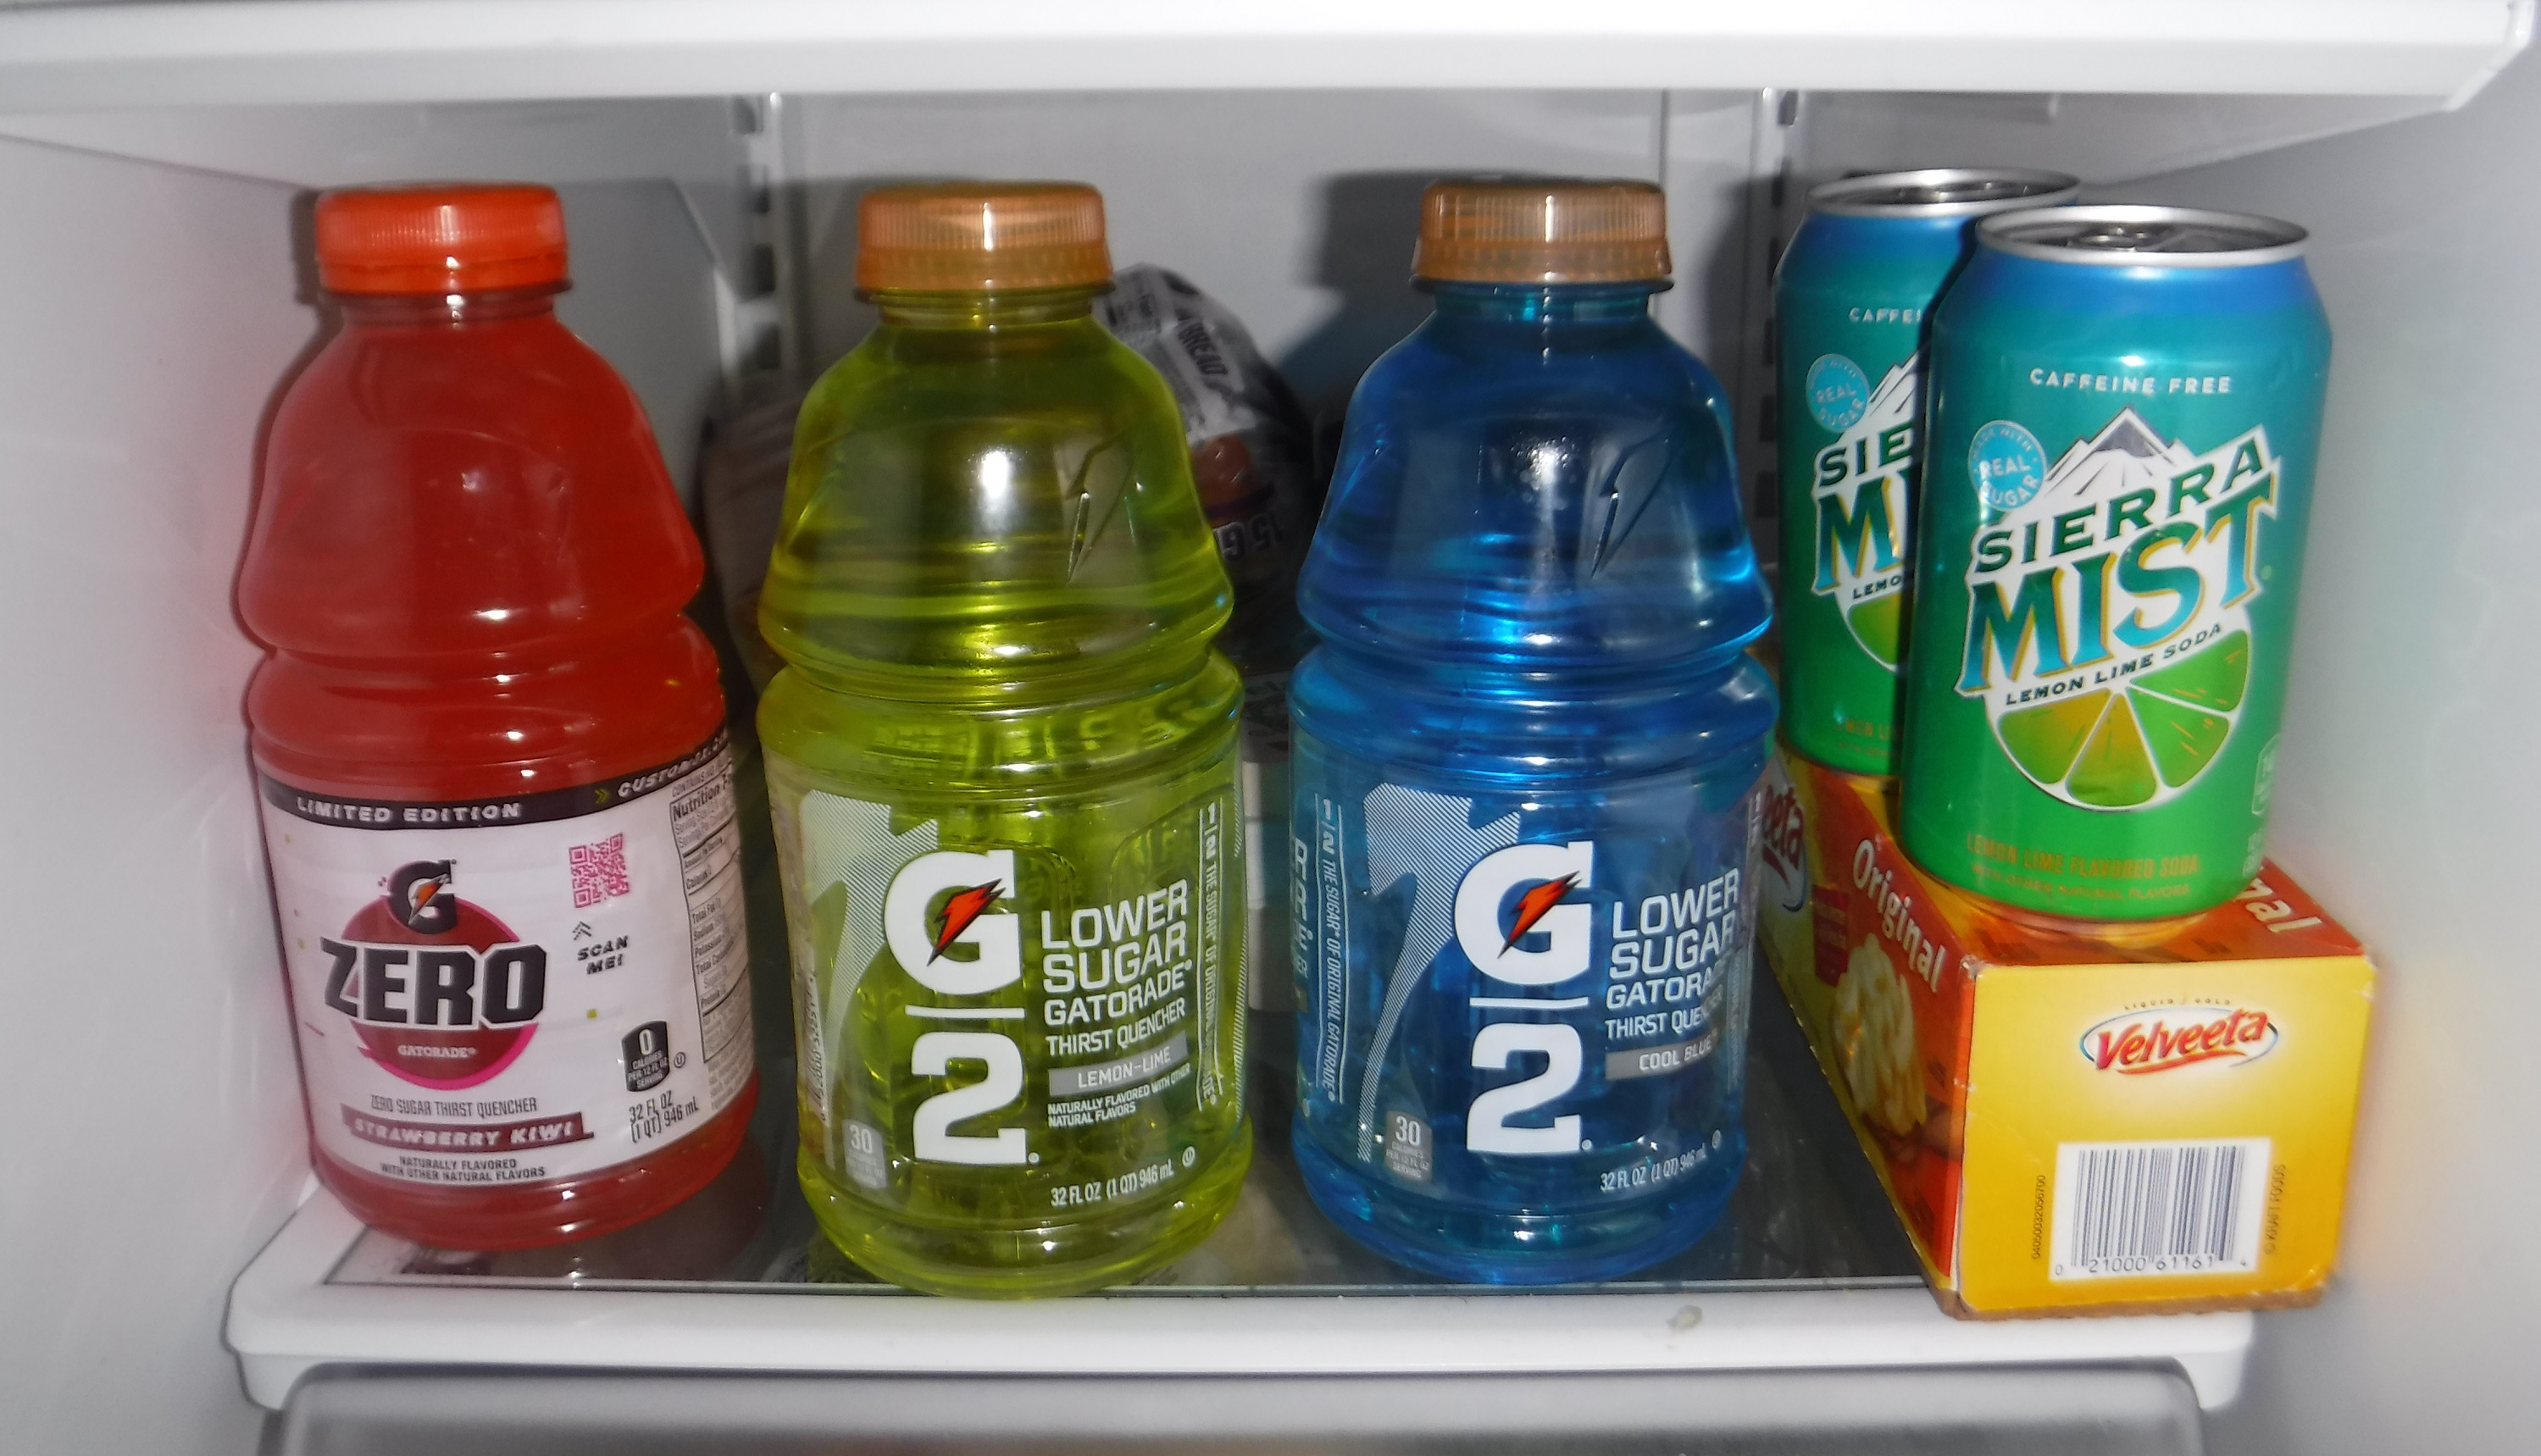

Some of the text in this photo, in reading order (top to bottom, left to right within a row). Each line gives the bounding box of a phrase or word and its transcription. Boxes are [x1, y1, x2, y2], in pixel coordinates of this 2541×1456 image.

[1849, 307, 1922, 324] CAFFEI
[1817, 383, 1857, 404] REAL
[2029, 367, 2233, 395] CAFFEINE FREE
[1818, 421, 1913, 488] SIE
[1978, 455, 2031, 479] REAL
[1975, 435, 2266, 573] SIERRA
[1978, 474, 2039, 507] SUGAR
[1852, 576, 1904, 601] LEMO
[1963, 471, 2277, 692] MIST
[2005, 622, 2222, 706] LEMON LIME SODA
[617, 746, 713, 800] CUSTOM
[297, 795, 521, 823] LIMITED EDITION
[672, 787, 721, 822] Nutrition
[1322, 858, 1338, 885] THE
[1967, 831, 2200, 879] LEMON LIME FLAVORED SODA
[1204, 861, 1218, 891] THE
[386, 859, 458, 936] G
[1040, 877, 1189, 950] LOWER
[1454, 840, 1594, 985] G
[1612, 867, 1740, 939] LOWER
[1852, 837, 1947, 994] Original
[883, 849, 1023, 996] G
[577, 935, 629, 961] SCAN
[585, 953, 624, 975] ME!
[1041, 919, 1188, 994] SUGAR
[1204, 944, 1218, 965] OF
[1326, 938, 1341, 957] OF
[1609, 909, 1737, 980] SUGAR
[319, 935, 548, 1026] ZERO
[1203, 966, 1218, 1032] ORIGINAL
[1326, 956, 1341, 1021] ORIGINAL
[1606, 955, 1725, 1010] GATORA
[1605, 983, 1723, 1042] THIRST QUEN
[2124, 998, 2174, 1010] LIQUID
[638, 1028, 654, 1056] 0
[1045, 996, 1187, 1058] THIRST QUENCHER
[2094, 1008, 2269, 1071] Velveeta
[1077, 1045, 1172, 1089] LEMON-LIME
[1639, 1035, 1713, 1071] COOL BLUE
[371, 1094, 539, 1120] ZERO SUGAR THIRST QUENCHER
[629, 1089, 674, 1124] 32 FL OZ
[911, 1031, 1027, 1165] 2
[1047, 1062, 1192, 1117] NATURALLY FLAVORED WITH OTHER
[1466, 1022, 1584, 1155] 2
[353, 1117, 575, 1147] STRAWBERRY KIWI
[663, 1106, 684, 1128] 946
[685, 1096, 699, 1116] mL
[1048, 1100, 1137, 1128] NATURAL FLAVORS
[1395, 1115, 1421, 1146] 30
[849, 1123, 873, 1154] 30
[399, 1155, 518, 1171] NATURALLY FLAVORED
[442, 1170, 492, 1182] NATURAL
[496, 1166, 546, 1181] FLAVORS
[1050, 1157, 1175, 1208] 32 FL OZ (1 QT) 946 mL
[1600, 1171, 1616, 1193] 32
[1617, 1170, 1631, 1188] FL
[1631, 1165, 1647, 1186] OZ
[1679, 1149, 1695, 1172] 946
[2272, 1164, 2287, 1204] FOODS
[2054, 1263, 2064, 1276] 0
[2089, 1257, 2148, 1273] 21000
[2155, 1255, 2216, 1271] 61161
